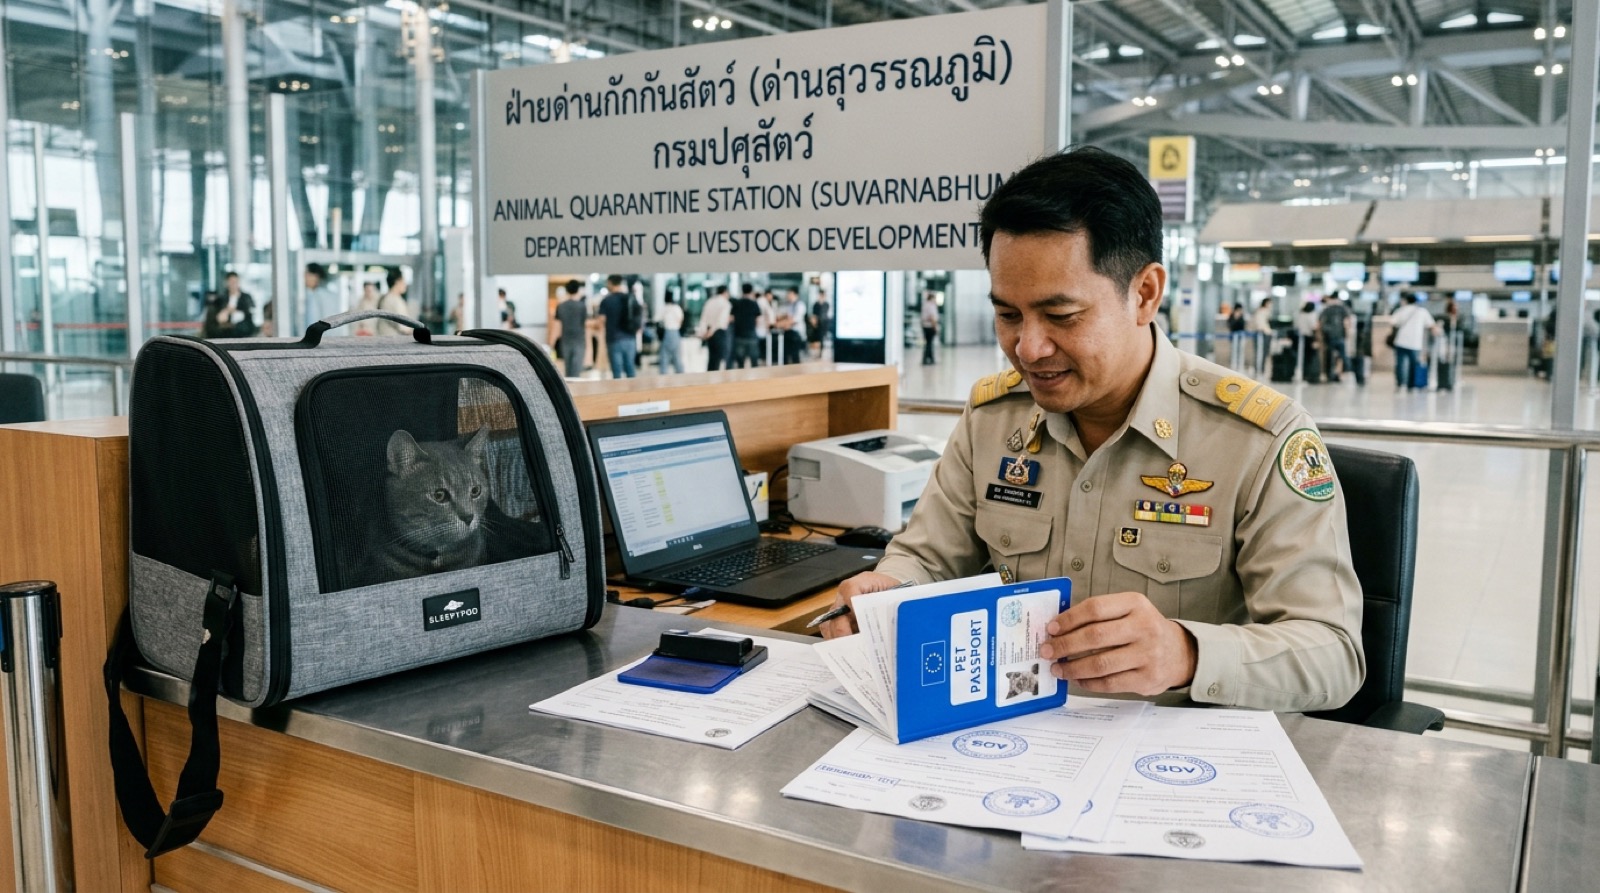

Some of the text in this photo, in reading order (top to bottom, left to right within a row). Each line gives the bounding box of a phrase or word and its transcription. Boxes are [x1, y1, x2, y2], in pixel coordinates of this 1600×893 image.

[506, 34, 1013, 126] ฝ่ายด่านกักกันสัตว์ (ด่านสุวรรณภูมิ)
[654, 112, 815, 179] กรมปศุสัตว์
[493, 197, 564, 222] ANIMAL
[569, 188, 701, 221] QUARANTINE
[706, 183, 802, 213] STATION
[524, 222, 982, 258] DEPARTMENT OF LIVESTOCK DEVELOPMENT
[955, 646, 966, 672] PET
[970, 619, 982, 694] PASSPORT
